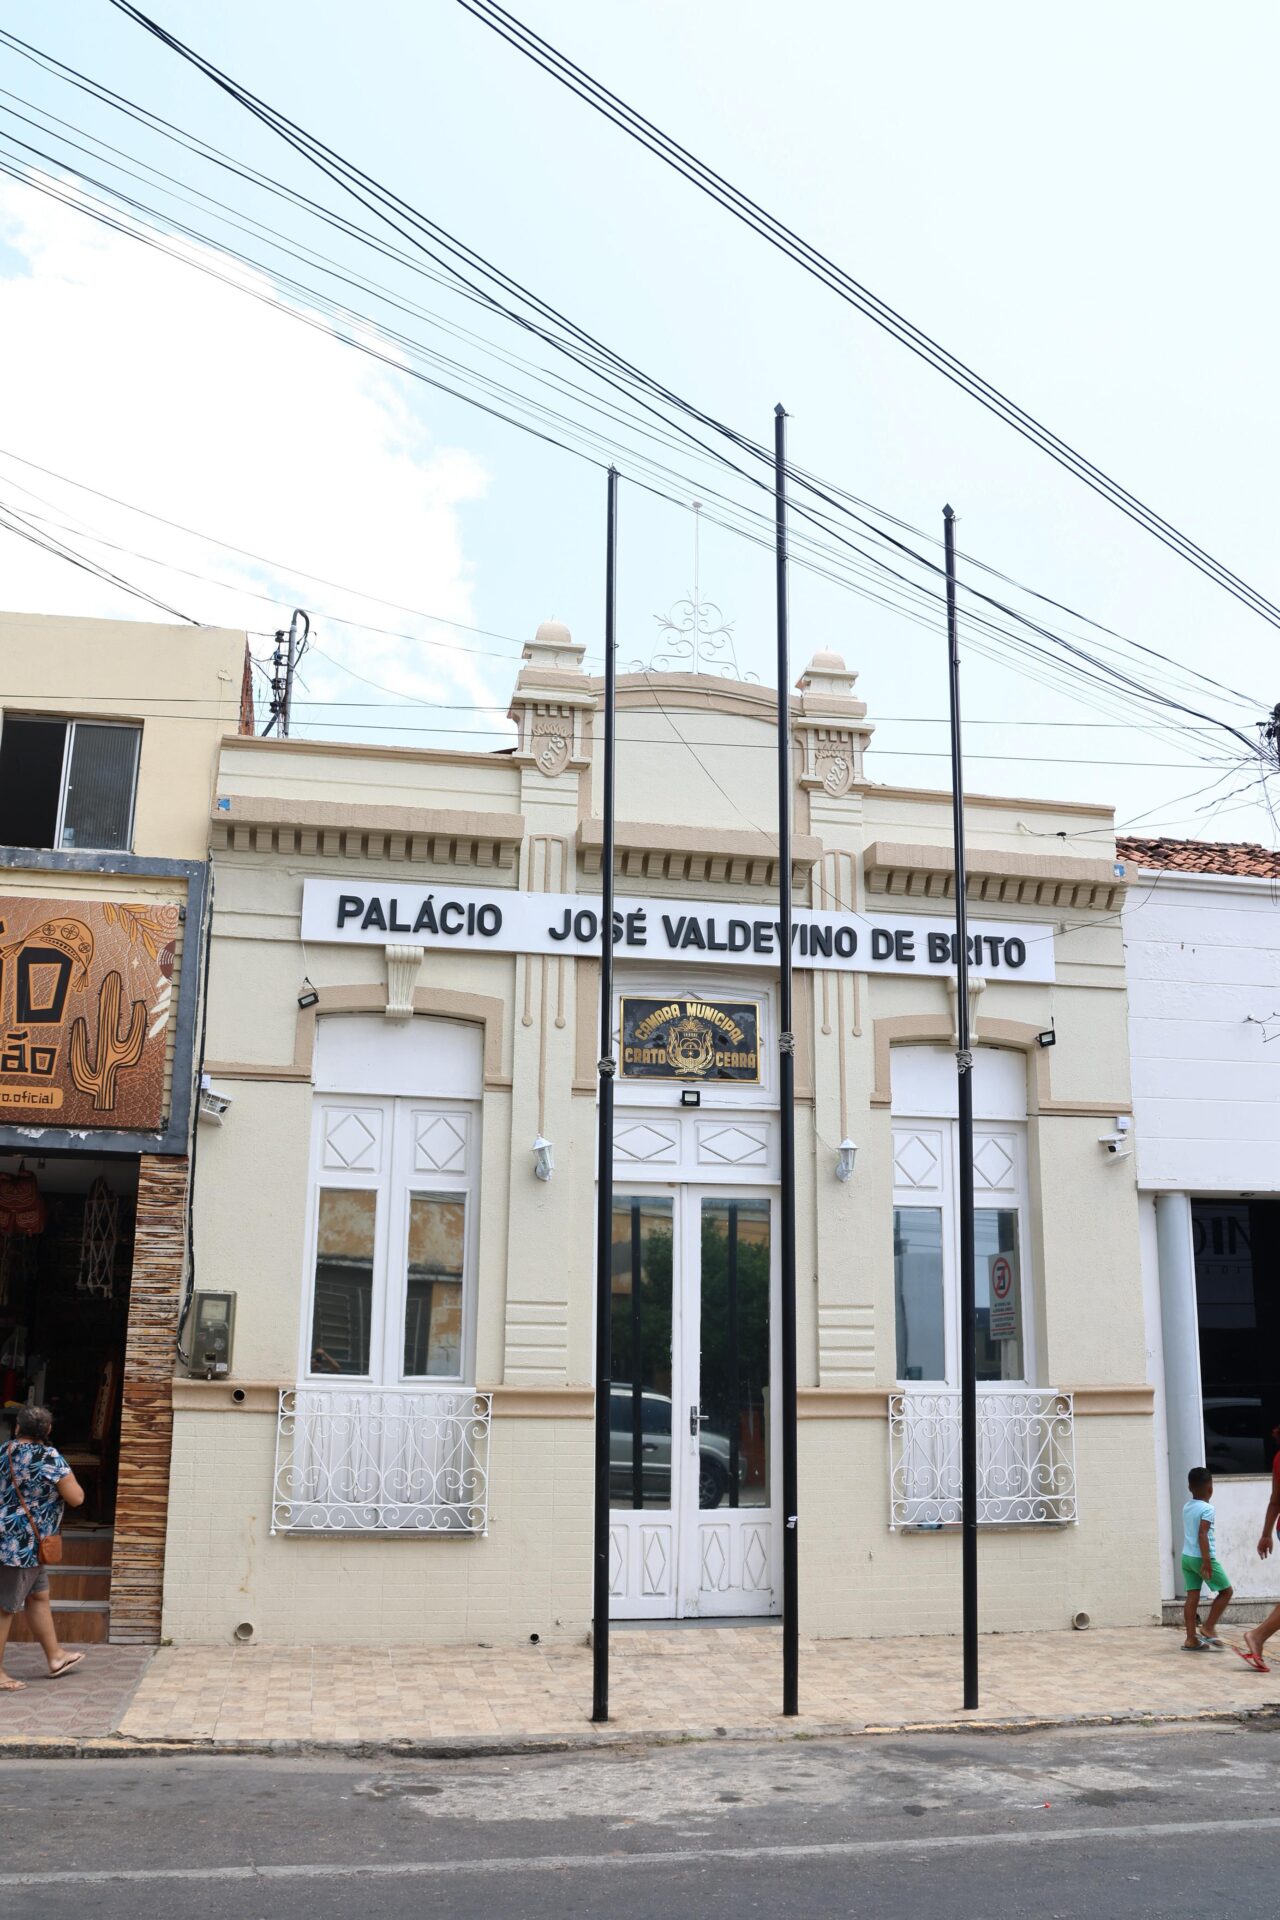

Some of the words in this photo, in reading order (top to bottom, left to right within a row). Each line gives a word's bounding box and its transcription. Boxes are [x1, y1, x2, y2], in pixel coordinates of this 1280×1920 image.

[826, 757, 847, 790] 1928
[337, 894, 503, 937] PALÁCIO
[548, 907, 647, 946] JOSÉ
[662, 915, 858, 958] VALDEVINO
[871, 928, 915, 961] DE
[927, 932, 1026, 968] BRITO
[686, 1002, 746, 1046] MUNICIPAL
[624, 1047, 666, 1065] CRATO
[0, 1091, 54, 1105] o.oficial
